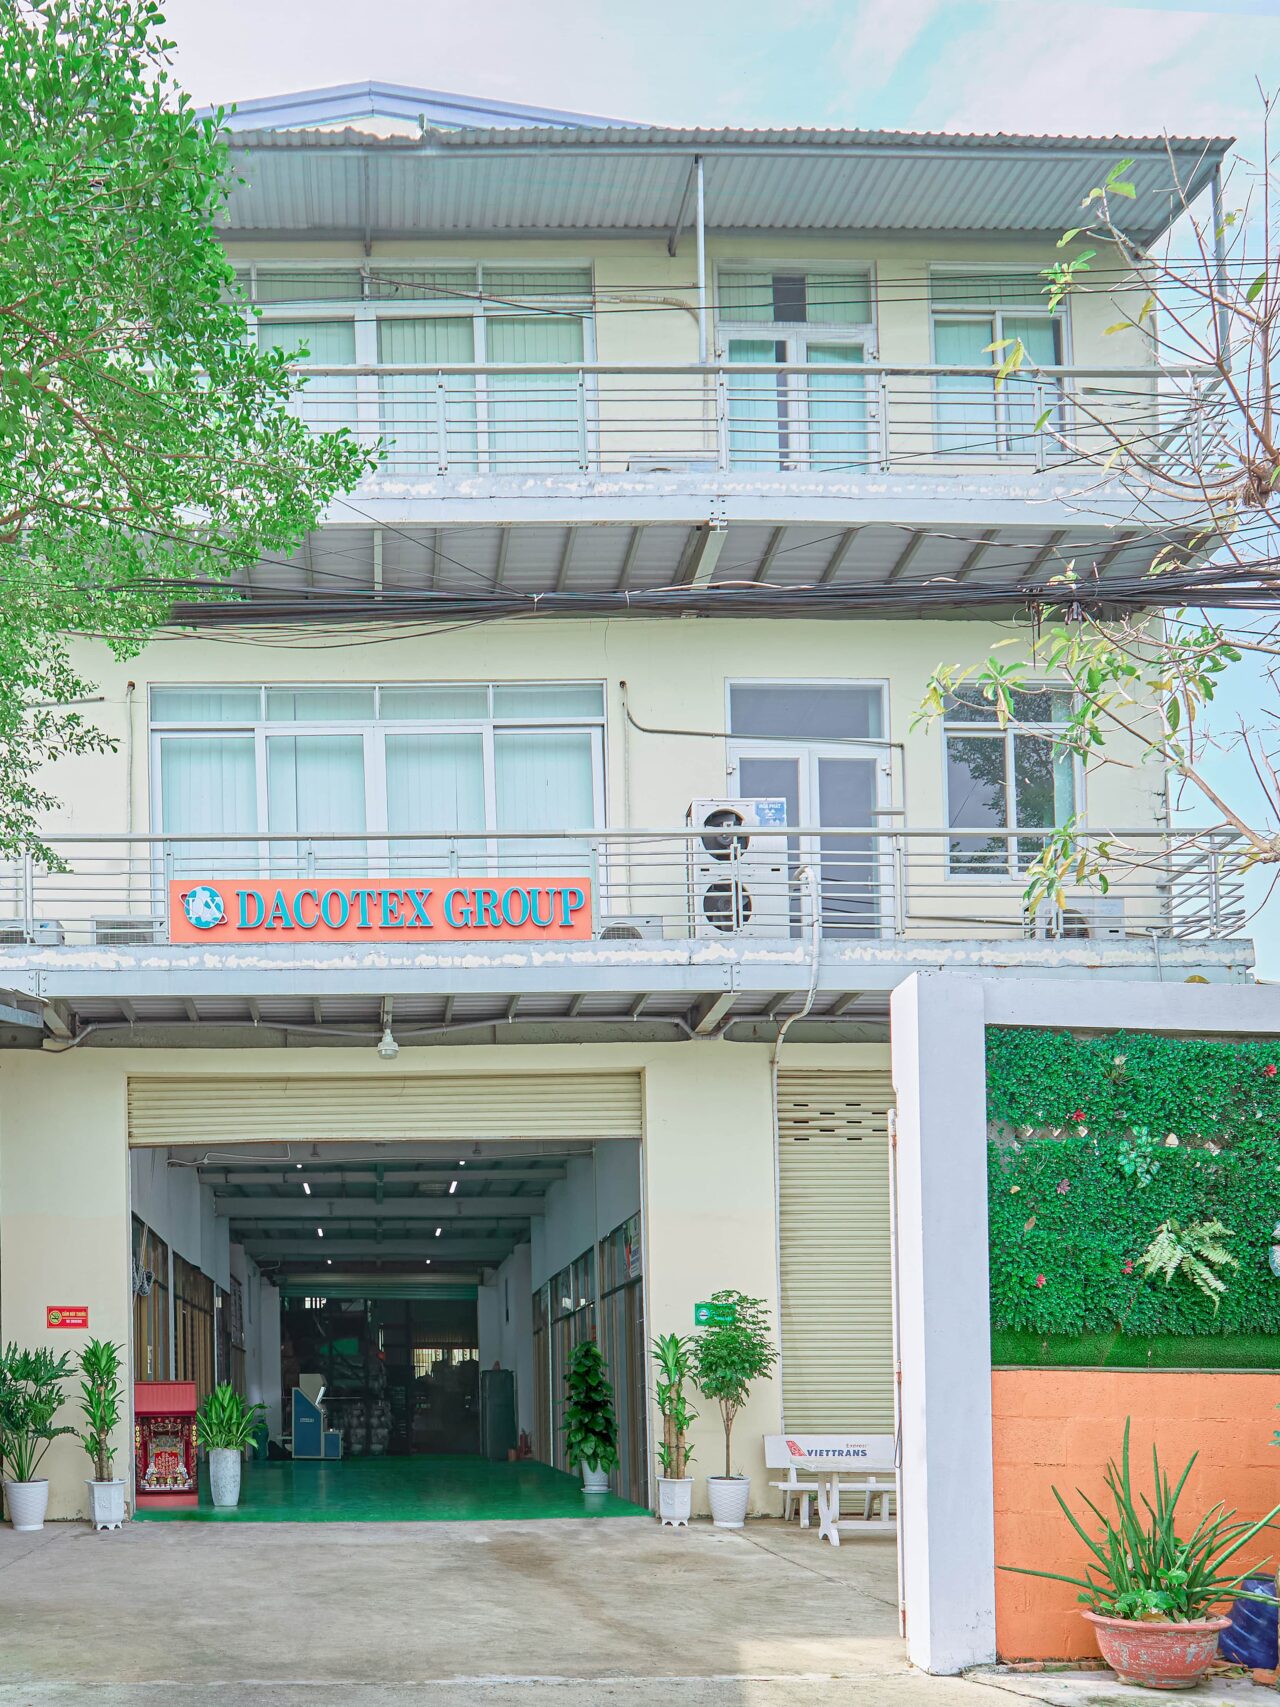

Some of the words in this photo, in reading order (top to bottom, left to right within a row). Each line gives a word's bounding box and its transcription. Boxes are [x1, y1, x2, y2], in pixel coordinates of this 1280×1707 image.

[235, 888, 433, 929] DACOTEX
[443, 886, 585, 929] GROUP
[807, 1449, 868, 1457] VIETTRANS
